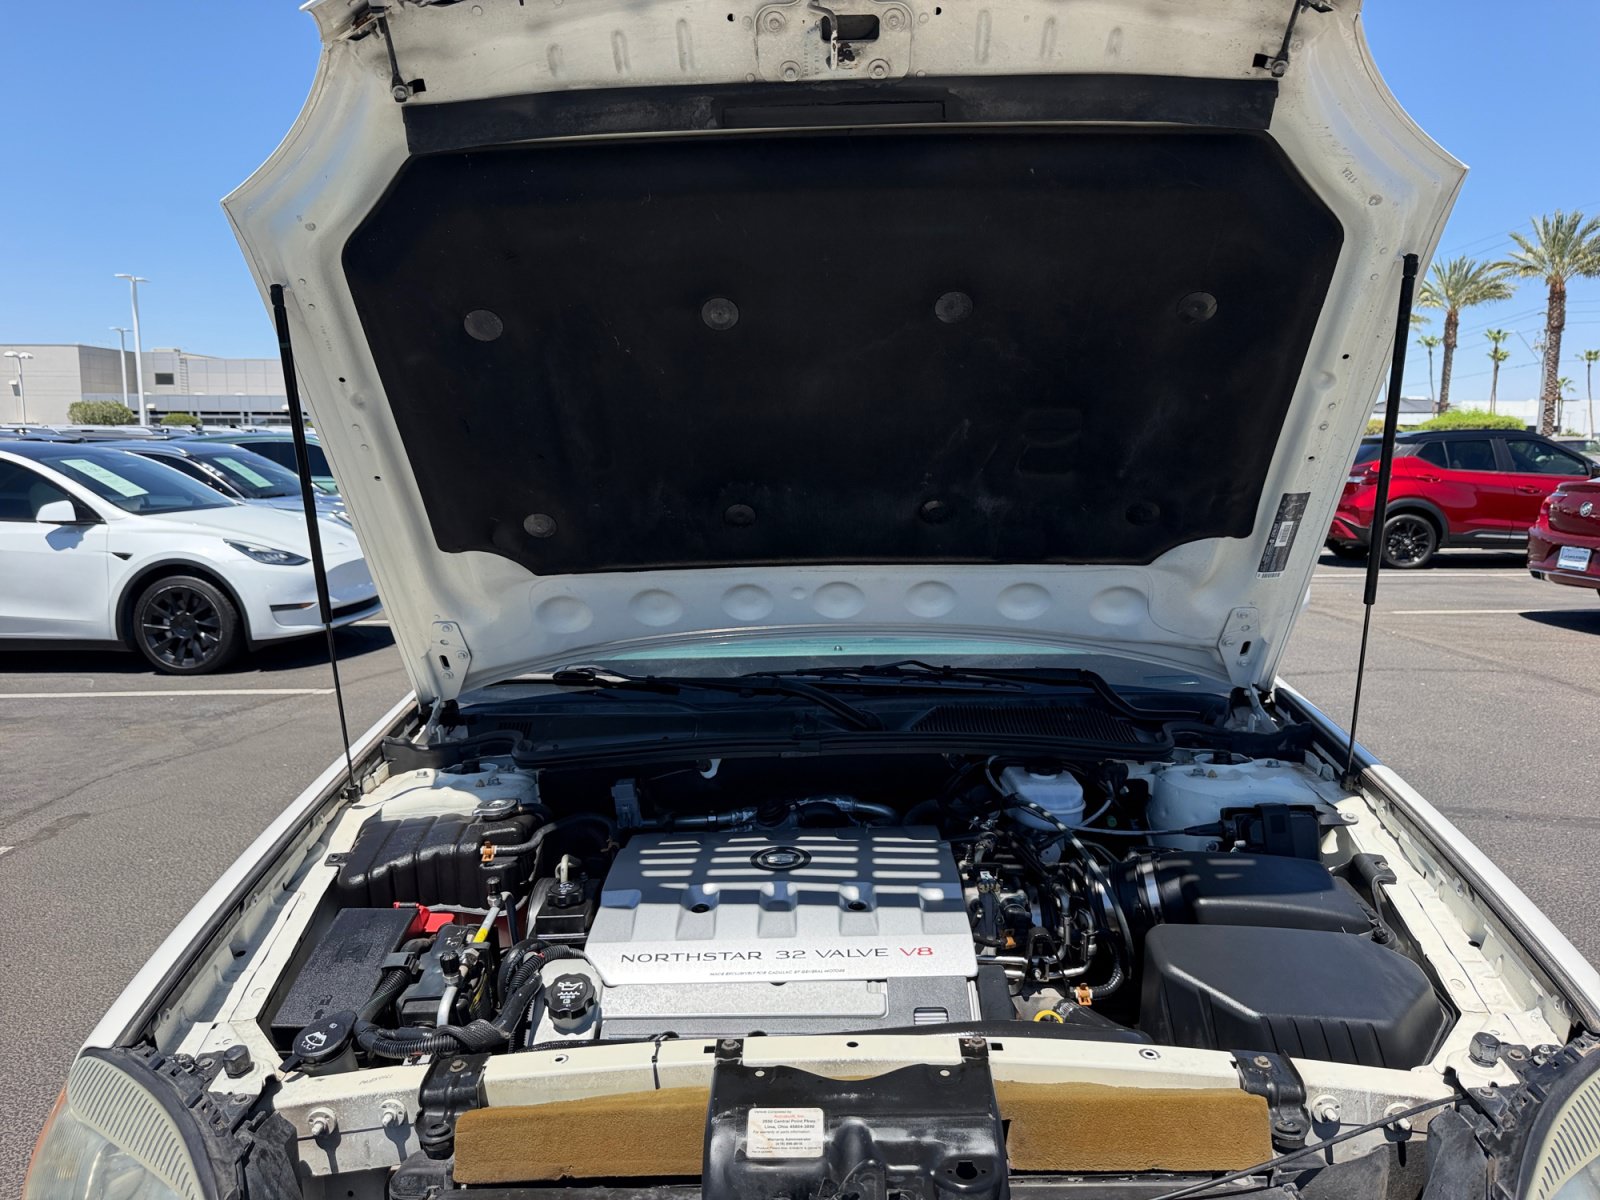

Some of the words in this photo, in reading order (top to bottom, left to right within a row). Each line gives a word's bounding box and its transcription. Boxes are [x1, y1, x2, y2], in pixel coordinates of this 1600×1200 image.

[621, 951, 762, 963] NORTHSTAR
[776, 950, 807, 960] 32
[816, 948, 889, 958] VALVE
[899, 947, 934, 957] V8
